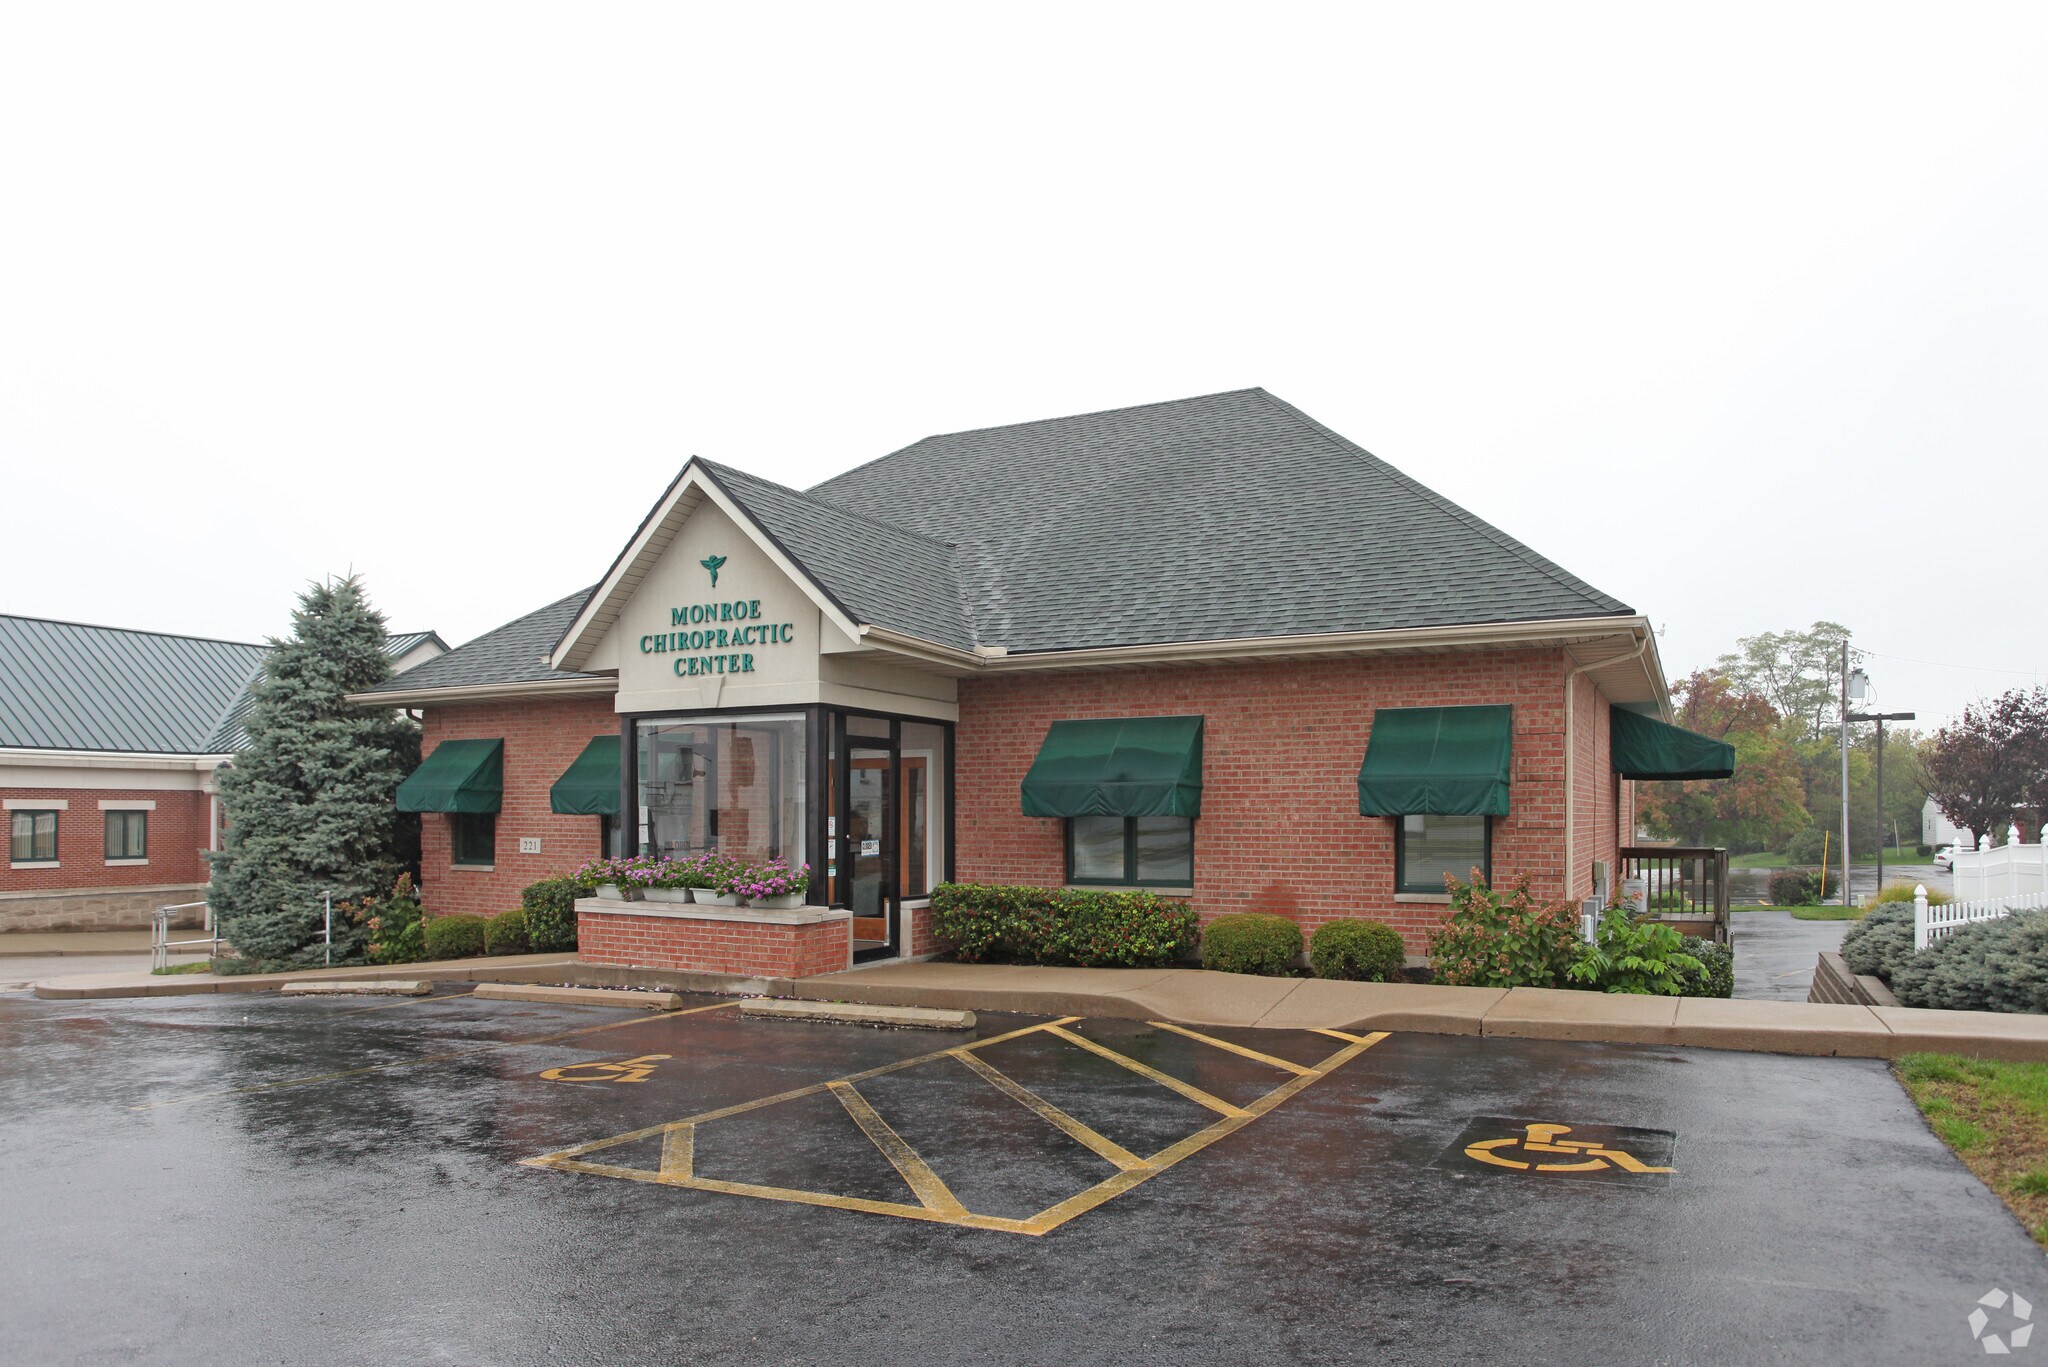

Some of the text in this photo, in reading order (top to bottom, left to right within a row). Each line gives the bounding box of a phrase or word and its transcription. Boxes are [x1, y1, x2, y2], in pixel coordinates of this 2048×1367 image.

[671, 600, 761, 626] MONROE
[640, 623, 794, 654] CHIROPRACTIC
[673, 653, 755, 677] CENTER
[523, 840, 537, 851] 221
